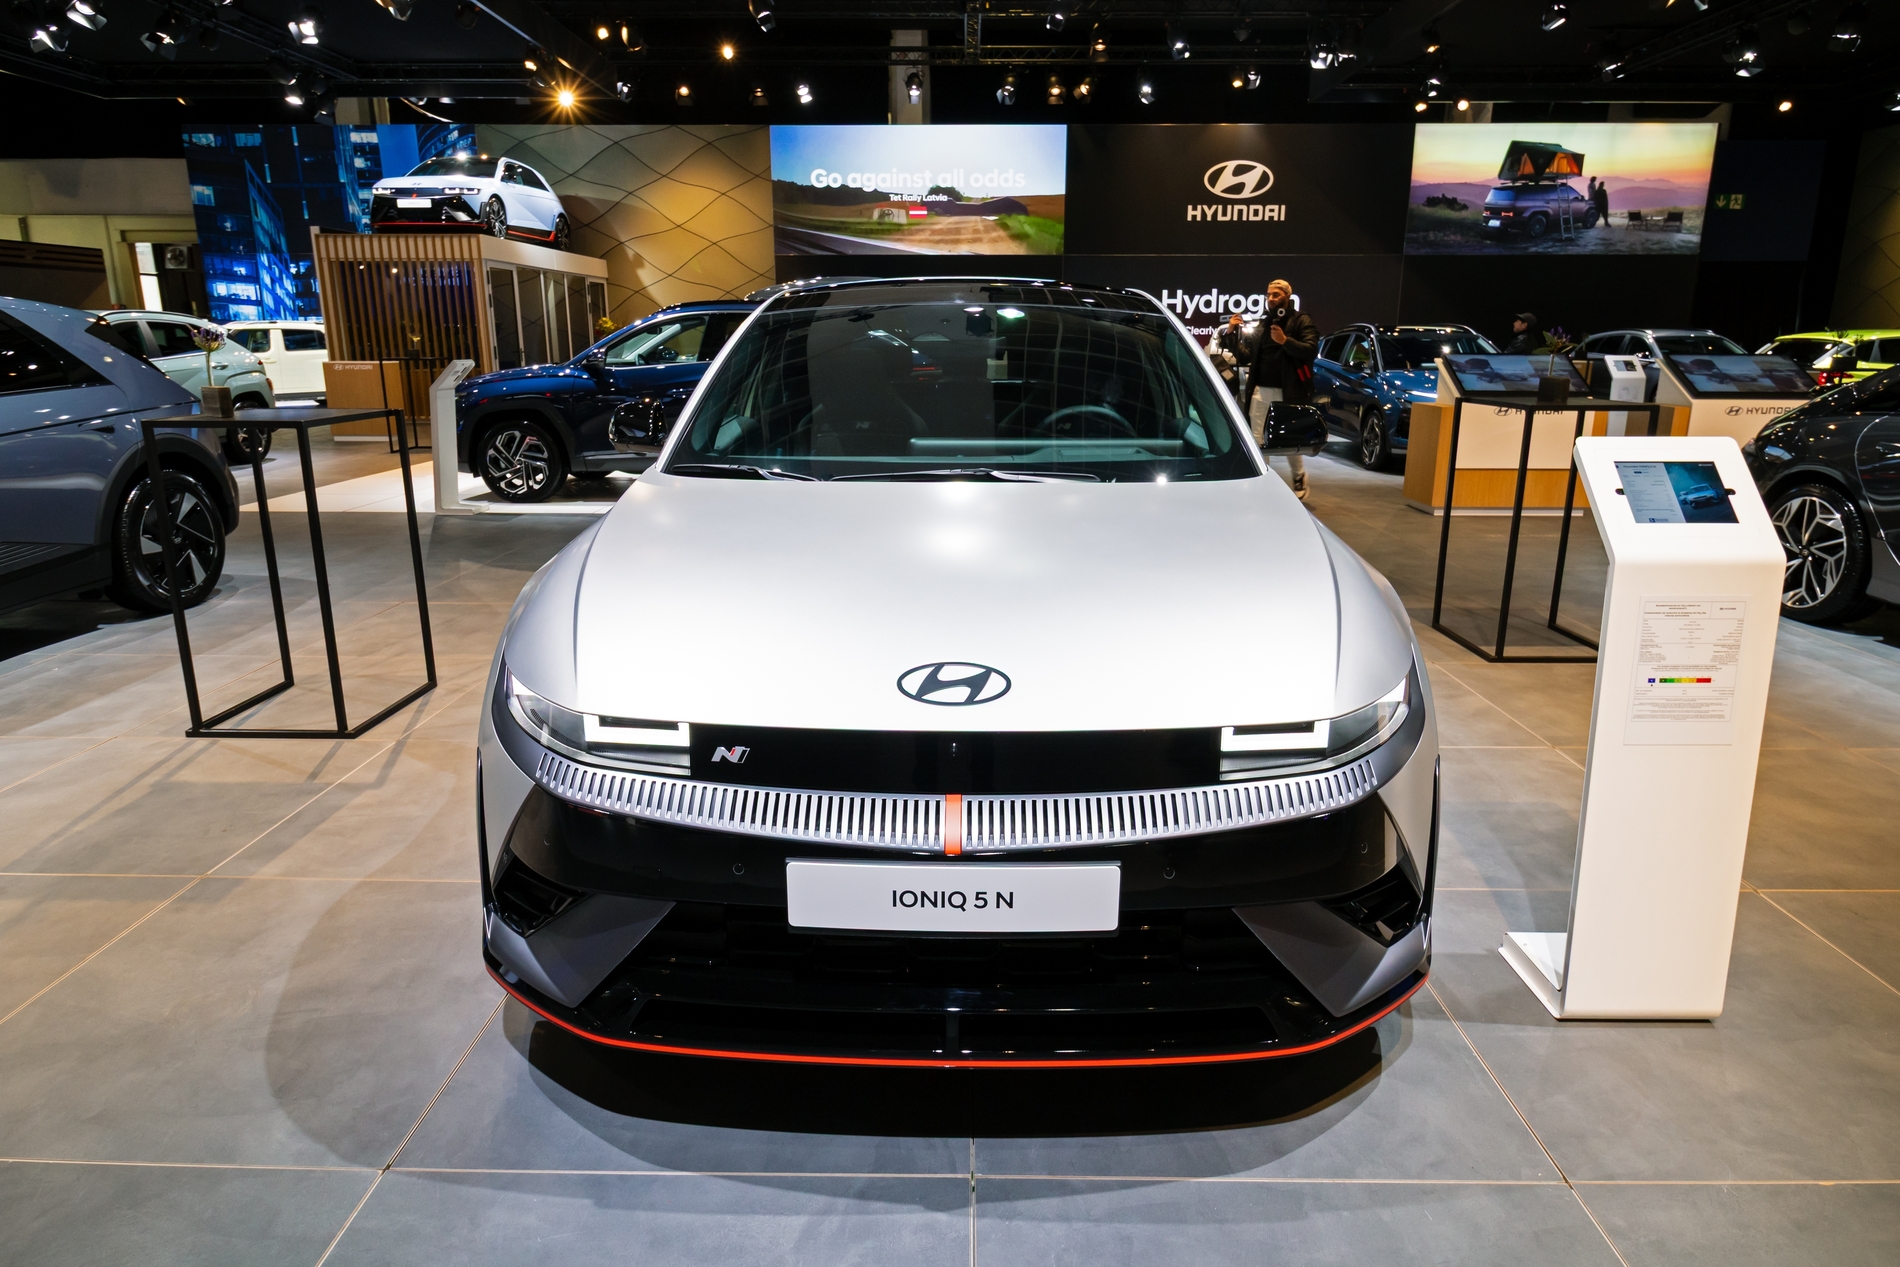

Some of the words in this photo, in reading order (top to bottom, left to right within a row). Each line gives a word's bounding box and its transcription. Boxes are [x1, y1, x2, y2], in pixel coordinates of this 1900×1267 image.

[810, 168, 842, 189] Go
[847, 168, 932, 192] against
[938, 168, 964, 188] all
[969, 168, 1026, 188] odds
[902, 194, 922, 203] Rally
[922, 193, 948, 202] Latvia
[1187, 204, 1286, 221] HYUNDAI
[1162, 288, 1300, 319] Hydrogn
[1746, 406, 1796, 415] HYUNDA
[892, 890, 966, 912] IONIQ
[973, 891, 988, 909] 5
[995, 891, 1013, 909] N
